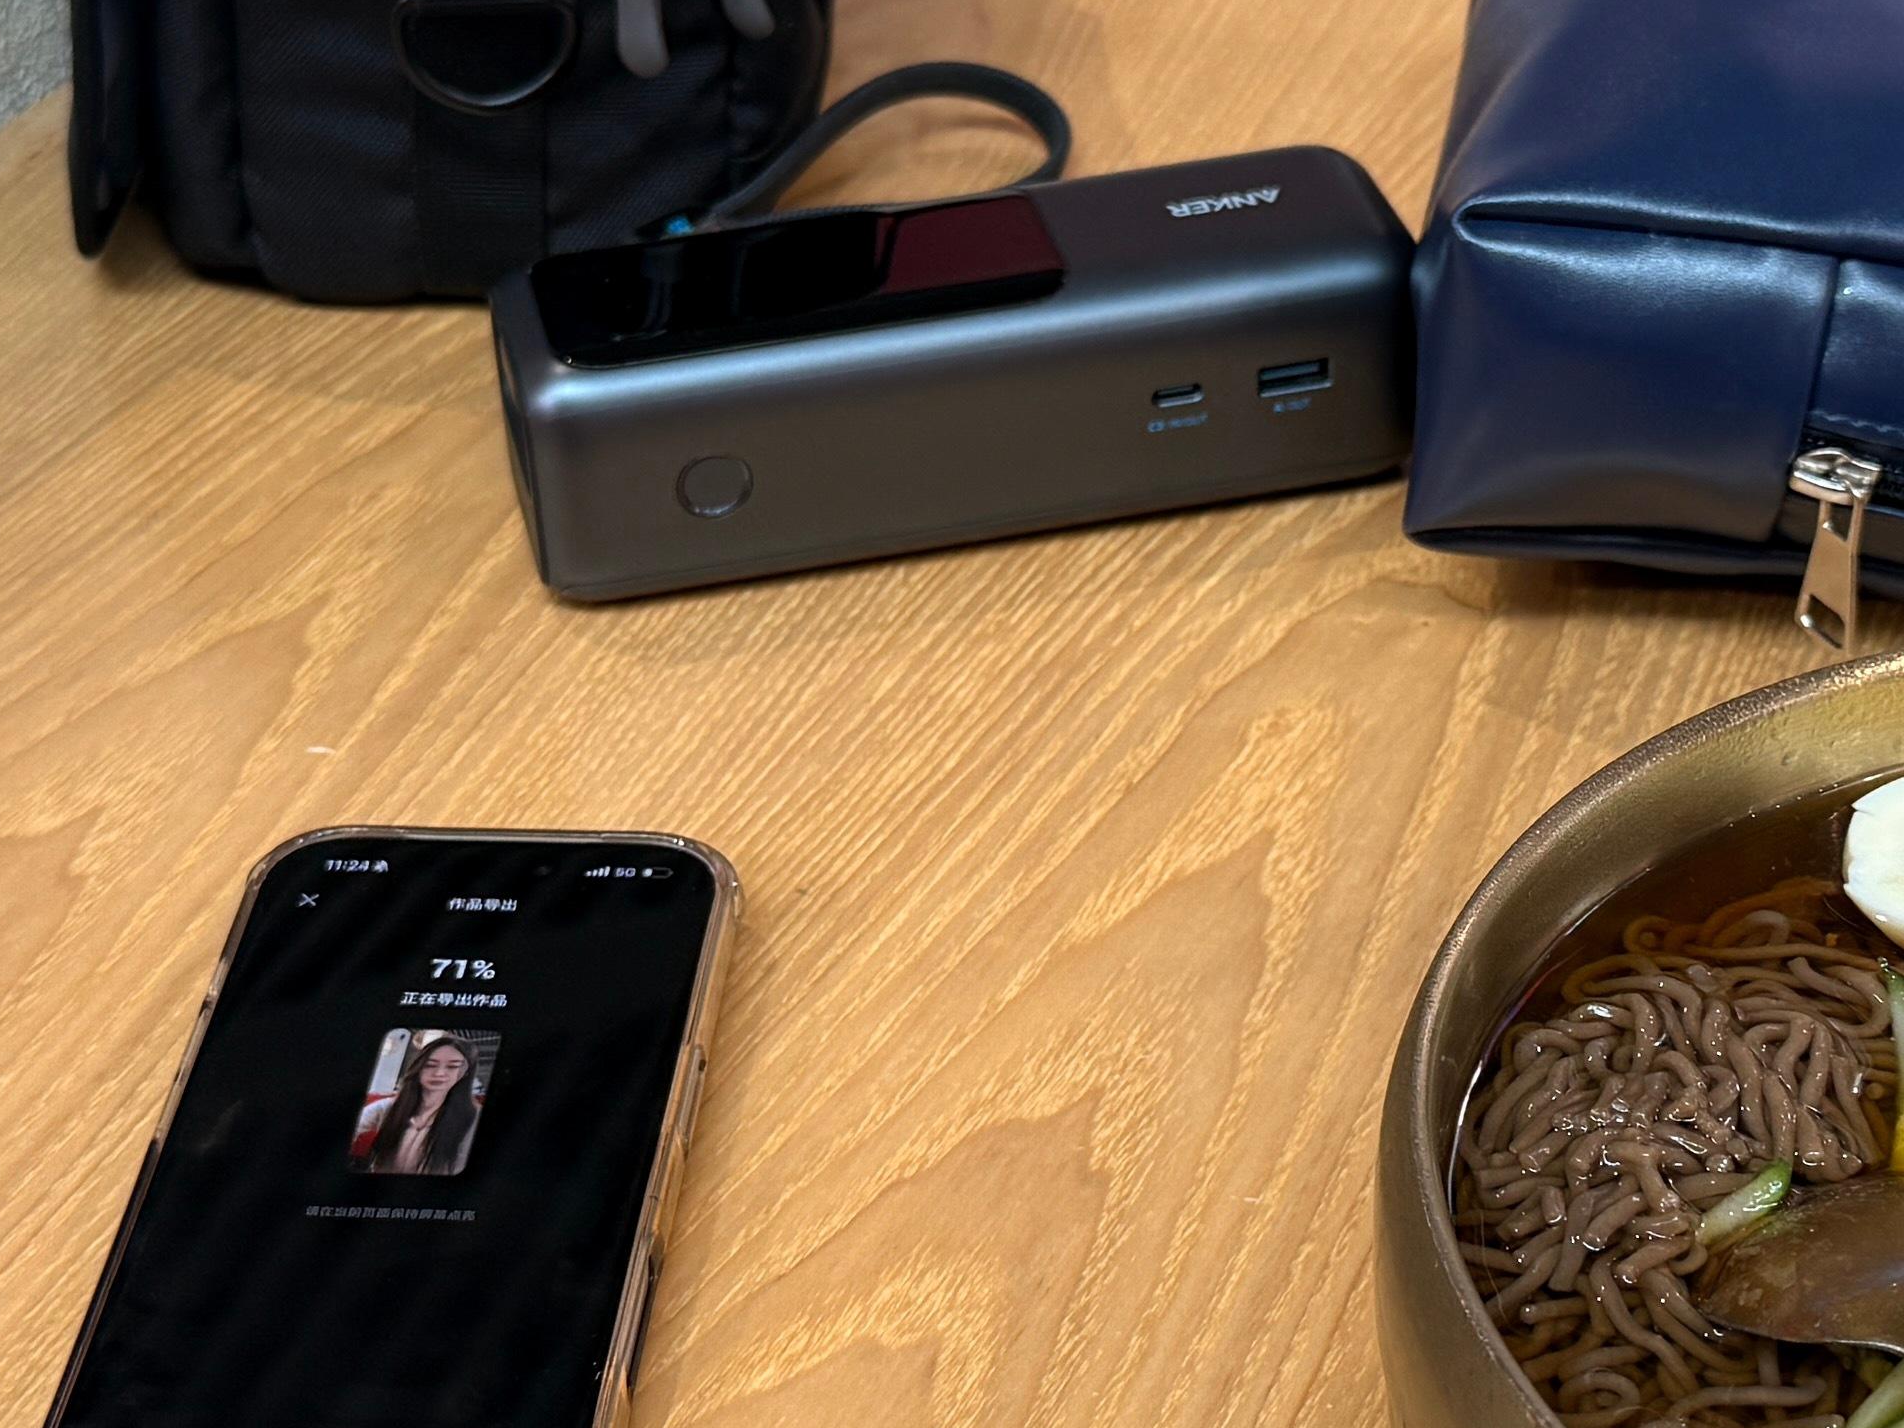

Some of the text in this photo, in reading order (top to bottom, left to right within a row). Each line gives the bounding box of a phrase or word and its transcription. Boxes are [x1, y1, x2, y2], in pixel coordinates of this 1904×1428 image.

[1166, 185, 1281, 218] ANKER
[325, 859, 370, 872] 11:24
[448, 897, 517, 912] 作品导出
[431, 958, 496, 980] 71%
[400, 991, 508, 1008] 正在导出作品
